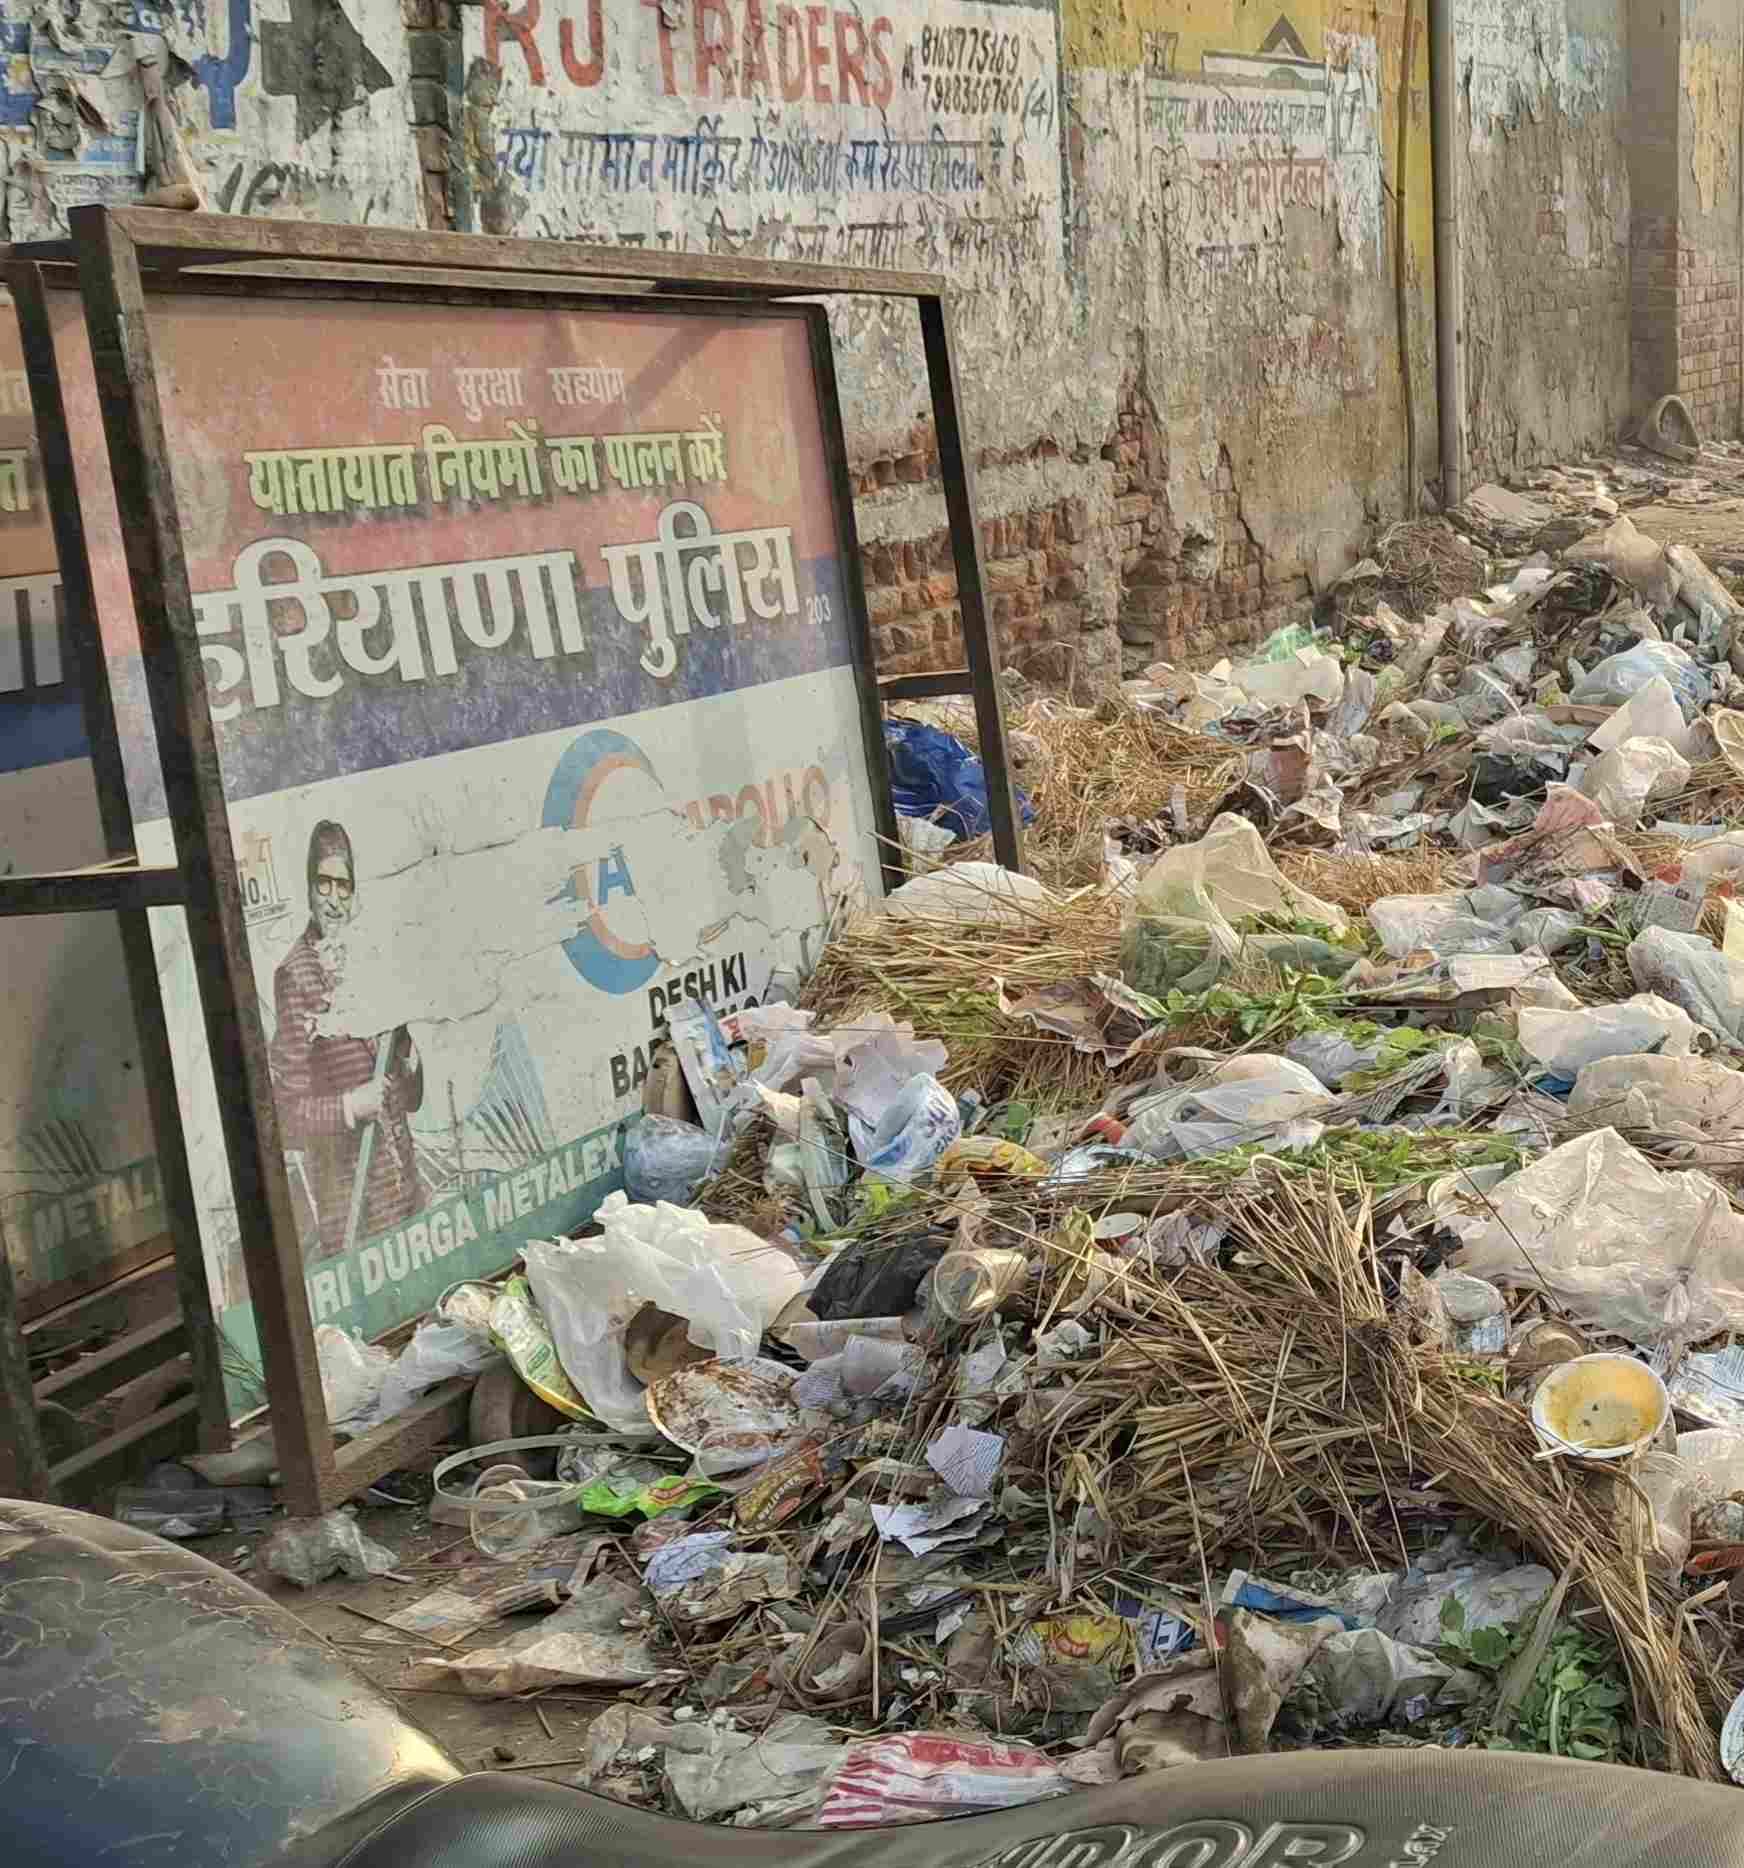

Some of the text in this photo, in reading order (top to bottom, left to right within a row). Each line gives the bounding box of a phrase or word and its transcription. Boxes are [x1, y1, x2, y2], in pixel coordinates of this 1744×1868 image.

[640, 0, 895, 110] TRADERS
[244, 411, 728, 514] यातायात नियमों का पालन करें
[192, 536, 586, 722] हरियाणा
[600, 500, 800, 678] पुलिस
[722, 951, 748, 998] KI
[359, 1197, 479, 1296] DURGA
[481, 1124, 626, 1233] METALEX
